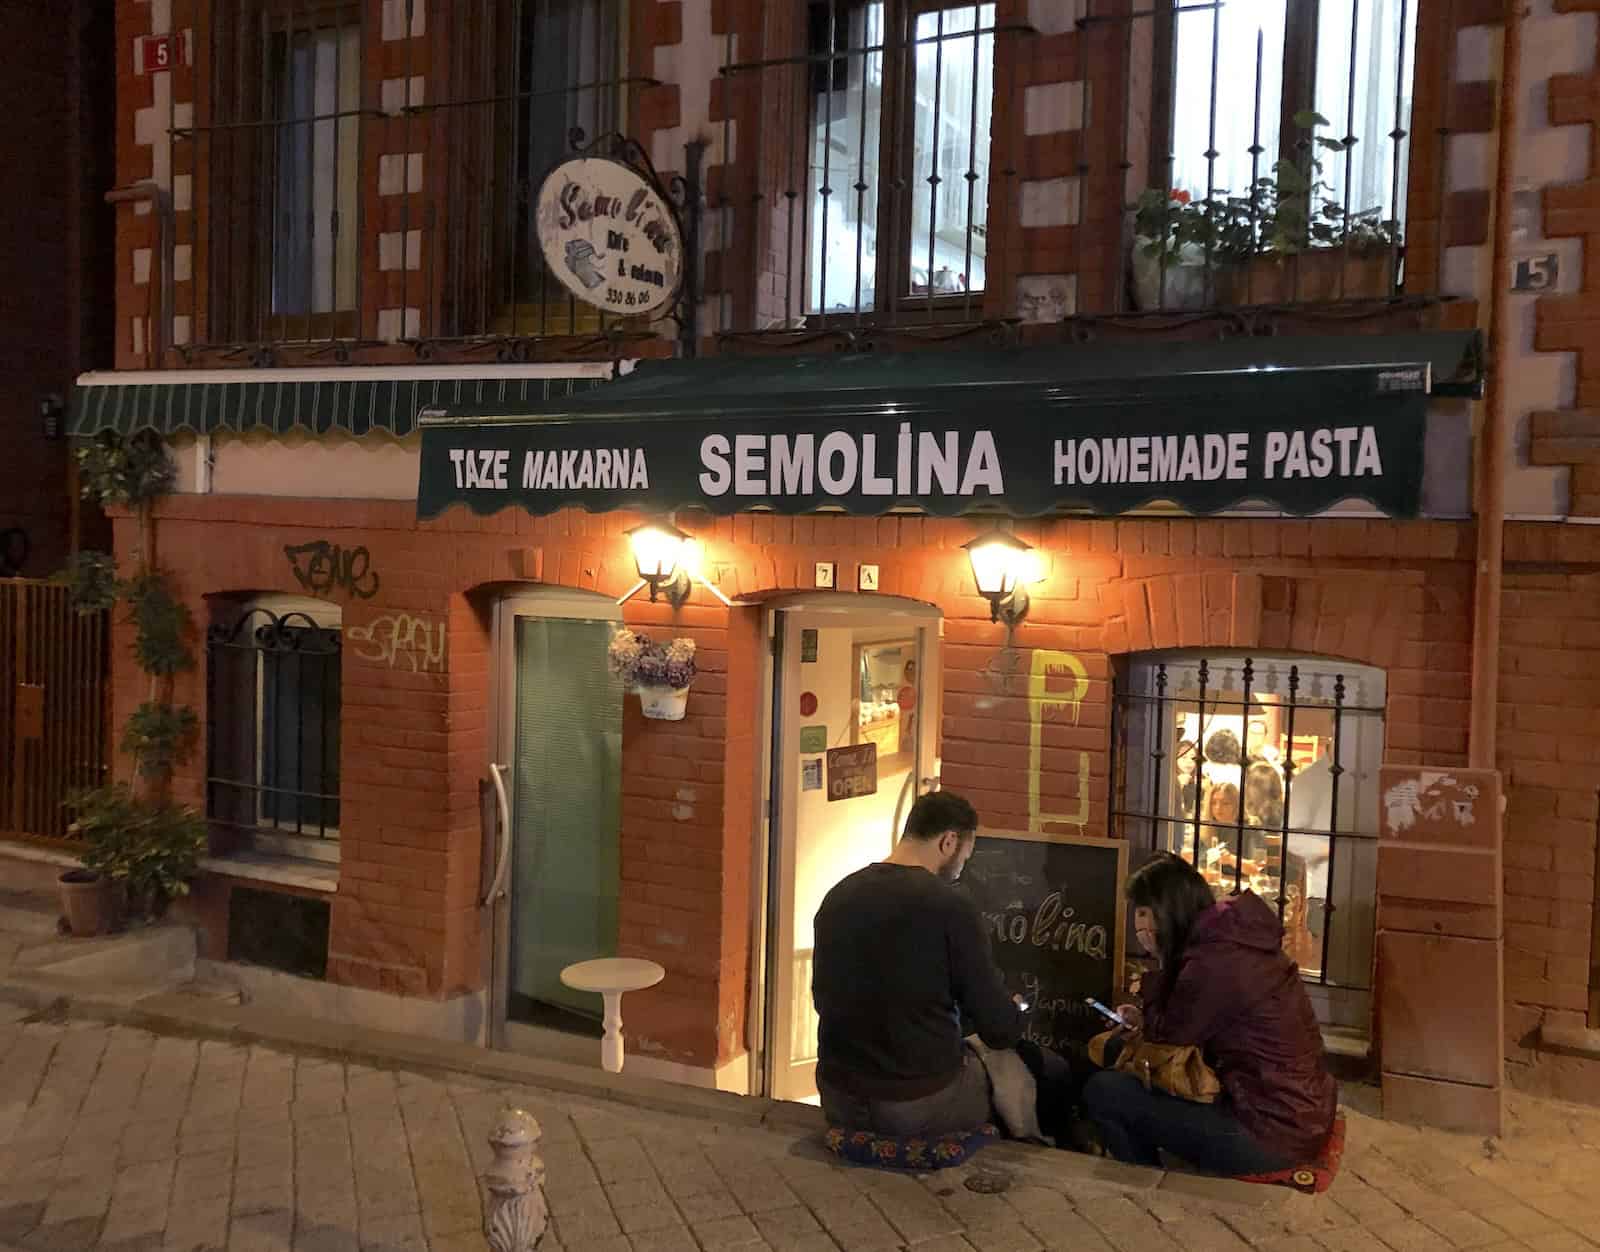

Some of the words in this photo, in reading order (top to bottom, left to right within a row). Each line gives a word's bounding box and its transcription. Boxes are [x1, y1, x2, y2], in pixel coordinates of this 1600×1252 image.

[157, 43, 168, 65] 5
[449, 449, 511, 489] TAZE
[522, 447, 650, 490] MAKARNA
[699, 421, 1005, 496] SEMOLİNA
[1053, 432, 1249, 485] HOMEMADE
[1263, 425, 1383, 481] PASTA
